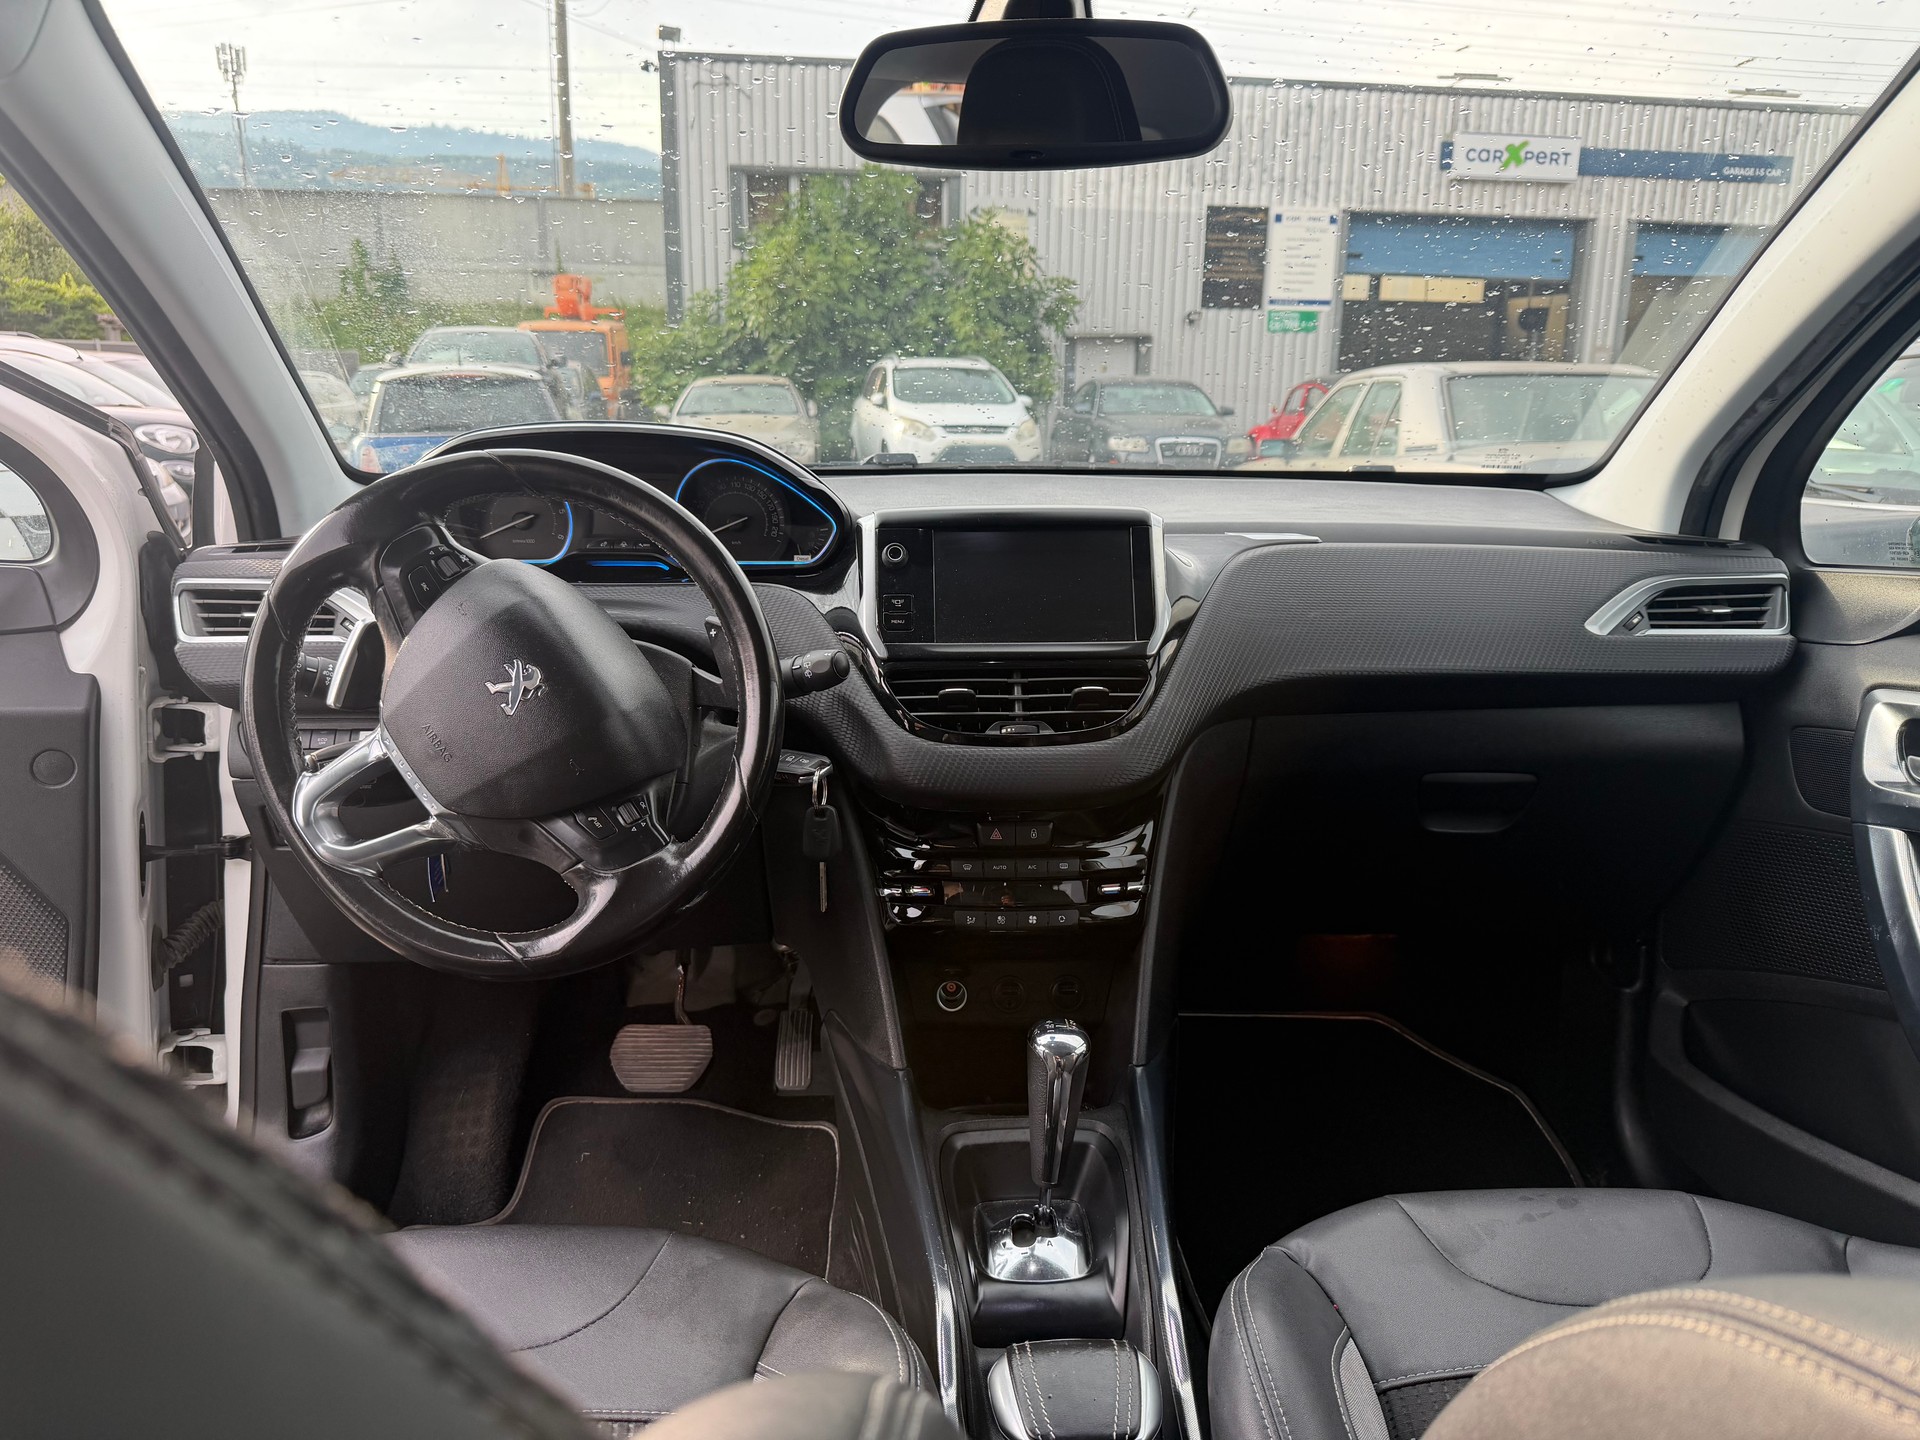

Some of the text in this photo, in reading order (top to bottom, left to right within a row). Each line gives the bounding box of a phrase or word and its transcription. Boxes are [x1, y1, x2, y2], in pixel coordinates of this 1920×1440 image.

[1723, 166, 1754, 176] GARAGE
[1765, 167, 1783, 177] CAR
[744, 483, 756, 492] 130
[757, 489, 768, 500] 150
[766, 499, 775, 511] 170
[421, 723, 453, 763] AIRBAG
[383, 738, 438, 811] PEUGEOT
